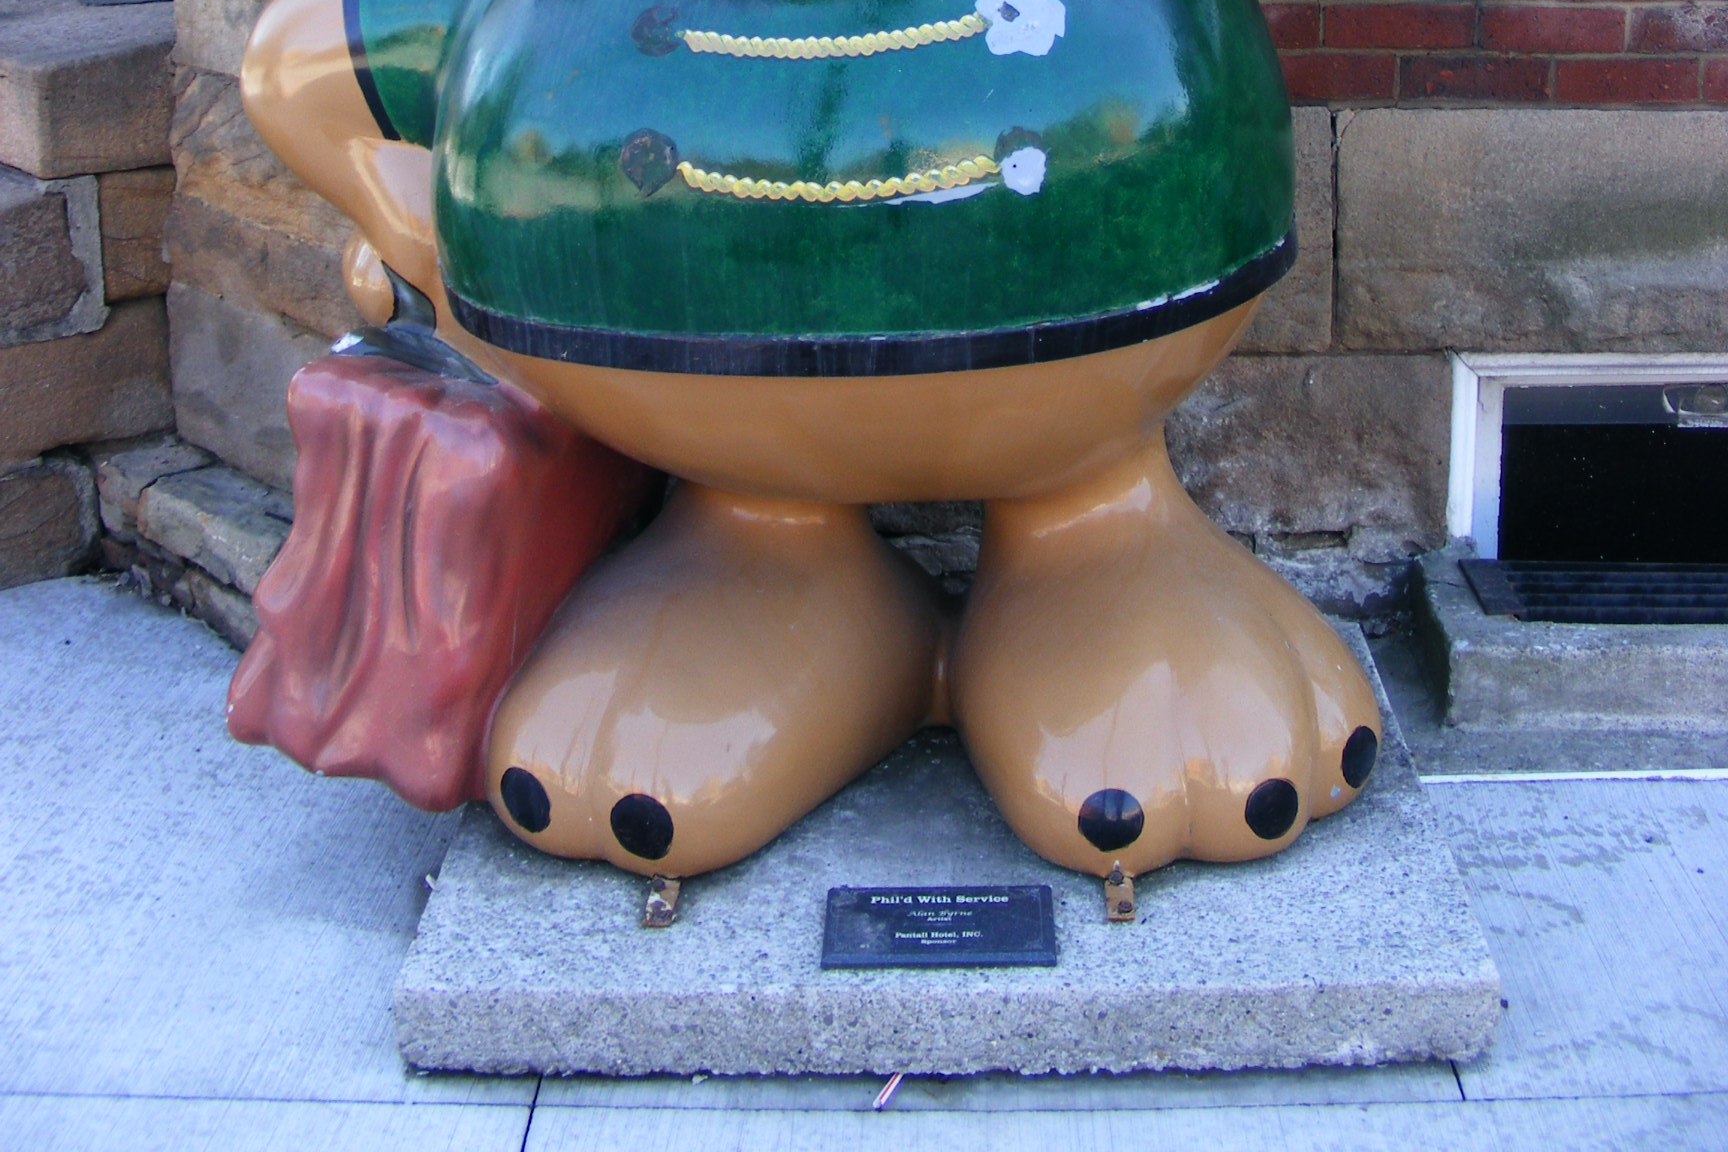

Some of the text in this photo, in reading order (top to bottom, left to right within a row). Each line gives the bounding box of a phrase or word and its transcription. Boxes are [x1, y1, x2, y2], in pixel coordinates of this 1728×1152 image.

[870, 895, 1009, 904] Phil'd With Service
[895, 930, 984, 939] Pantall Hotel, INC.
